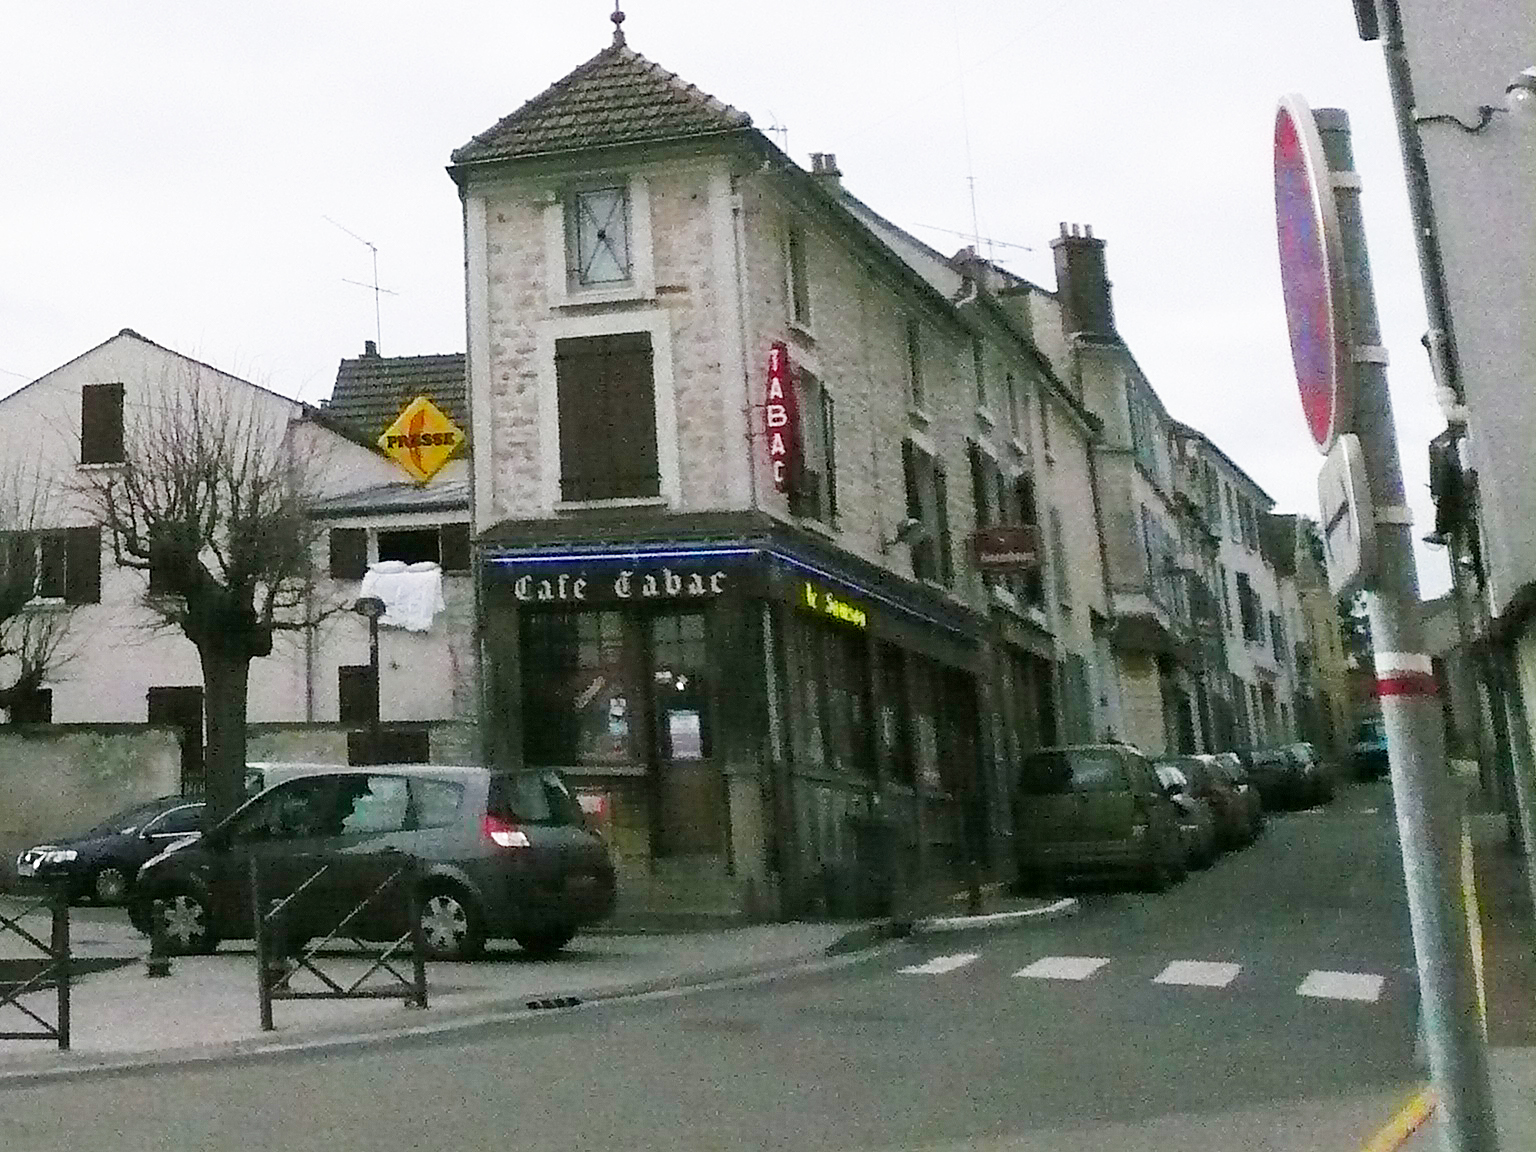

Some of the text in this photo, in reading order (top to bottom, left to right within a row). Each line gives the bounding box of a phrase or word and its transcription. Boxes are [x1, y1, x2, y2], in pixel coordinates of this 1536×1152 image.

[766, 348, 788, 482] TABAC
[386, 432, 455, 449] PRESSE
[514, 567, 727, 600] Café Tabac
